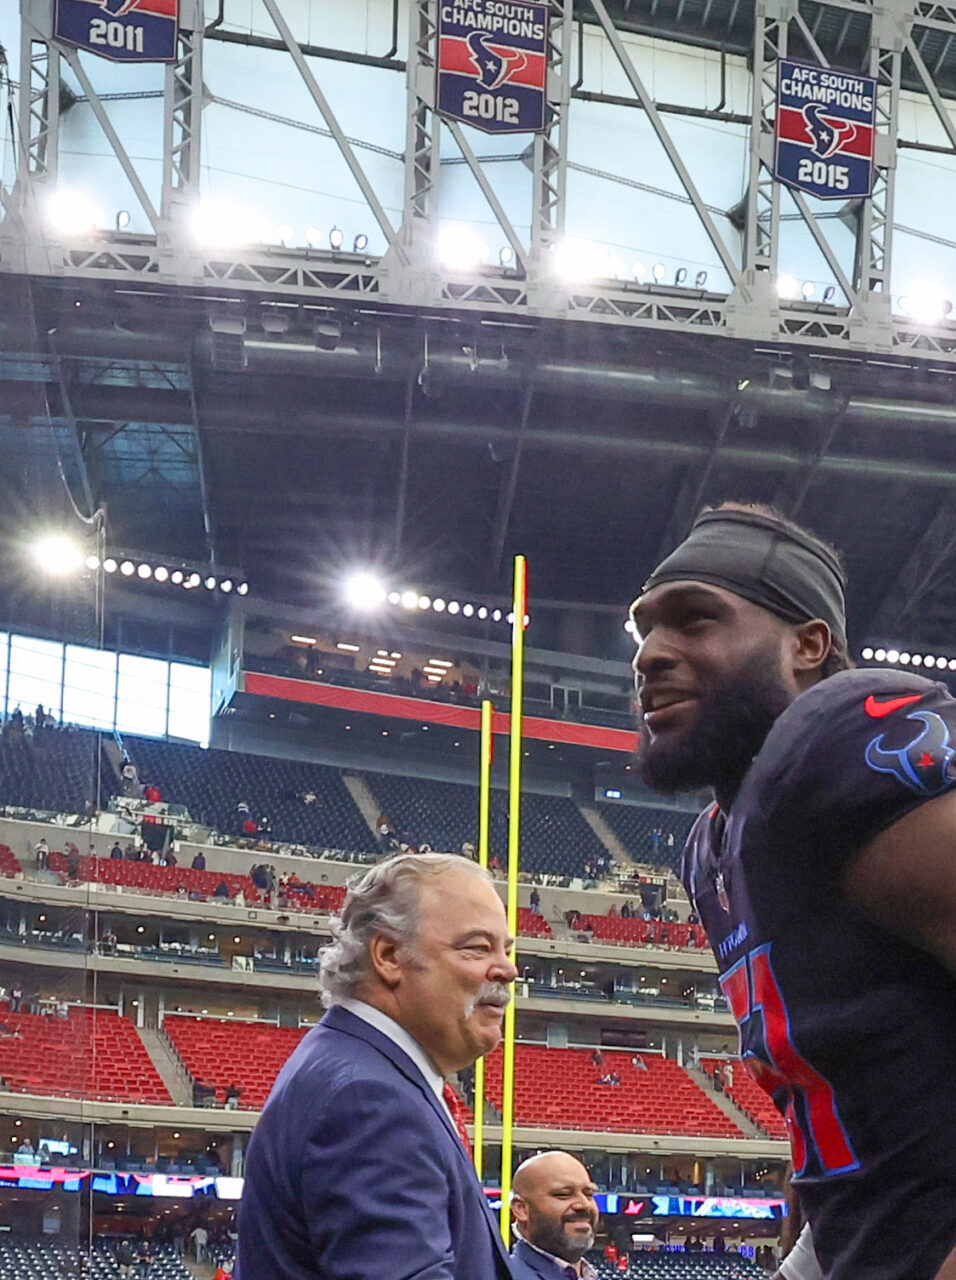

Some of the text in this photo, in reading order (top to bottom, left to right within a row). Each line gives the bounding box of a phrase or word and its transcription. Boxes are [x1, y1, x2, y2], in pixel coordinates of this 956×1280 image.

[441, 6, 544, 40] CHAMPIONS
[453, 0, 534, 21] AFC SOUTH
[89, 18, 144, 53] 2011
[781, 79, 873, 112] CHAMPIONS
[792, 67, 864, 93] AFC SOUTH
[462, 90, 520, 124] 2012
[798, 158, 849, 190] 2015
